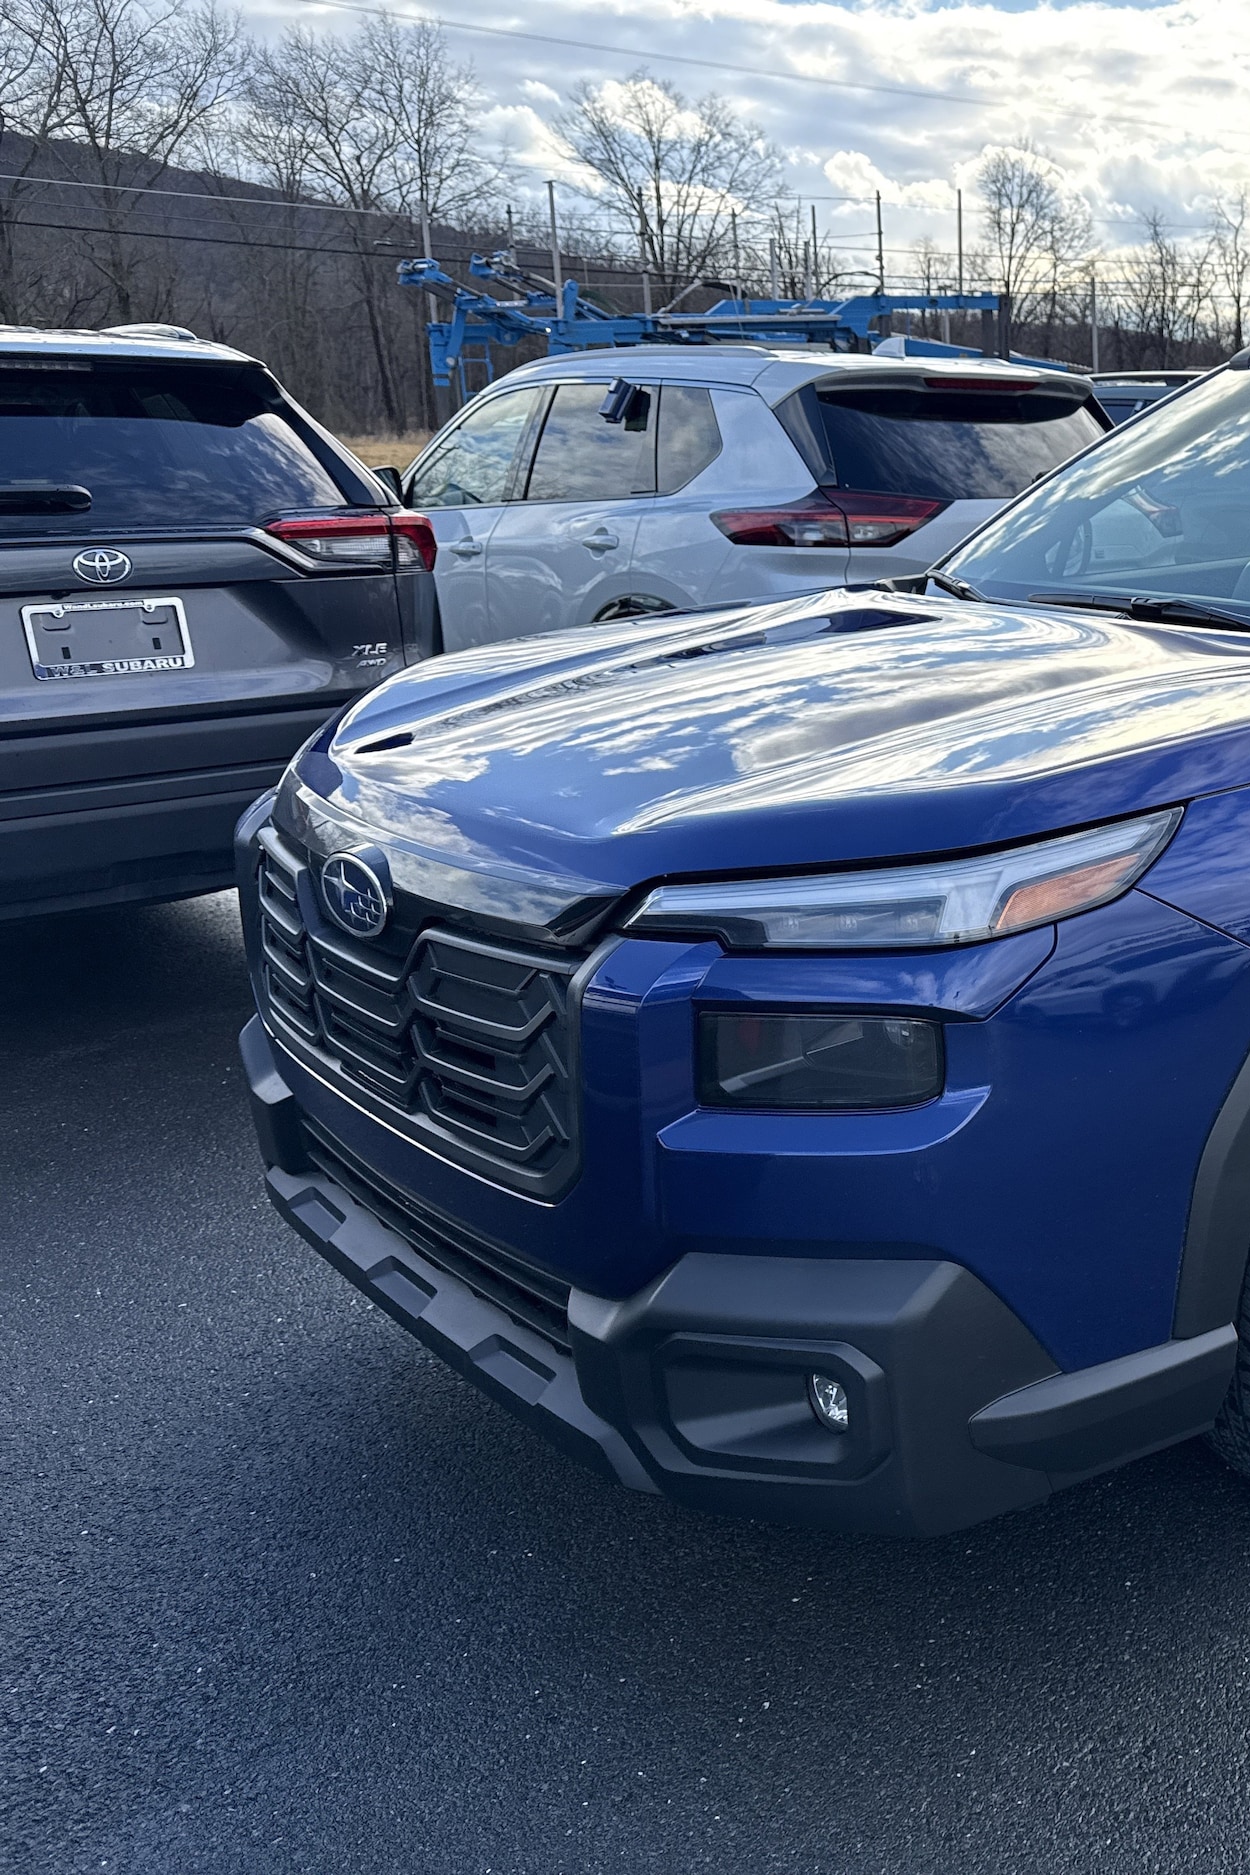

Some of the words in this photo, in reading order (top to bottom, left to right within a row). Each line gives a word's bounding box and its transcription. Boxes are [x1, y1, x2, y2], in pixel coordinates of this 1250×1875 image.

[351, 642, 388, 657] XLE
[51, 665, 97, 677] W&L
[101, 657, 183, 673] SUBARU
[355, 657, 387, 669] AWD
